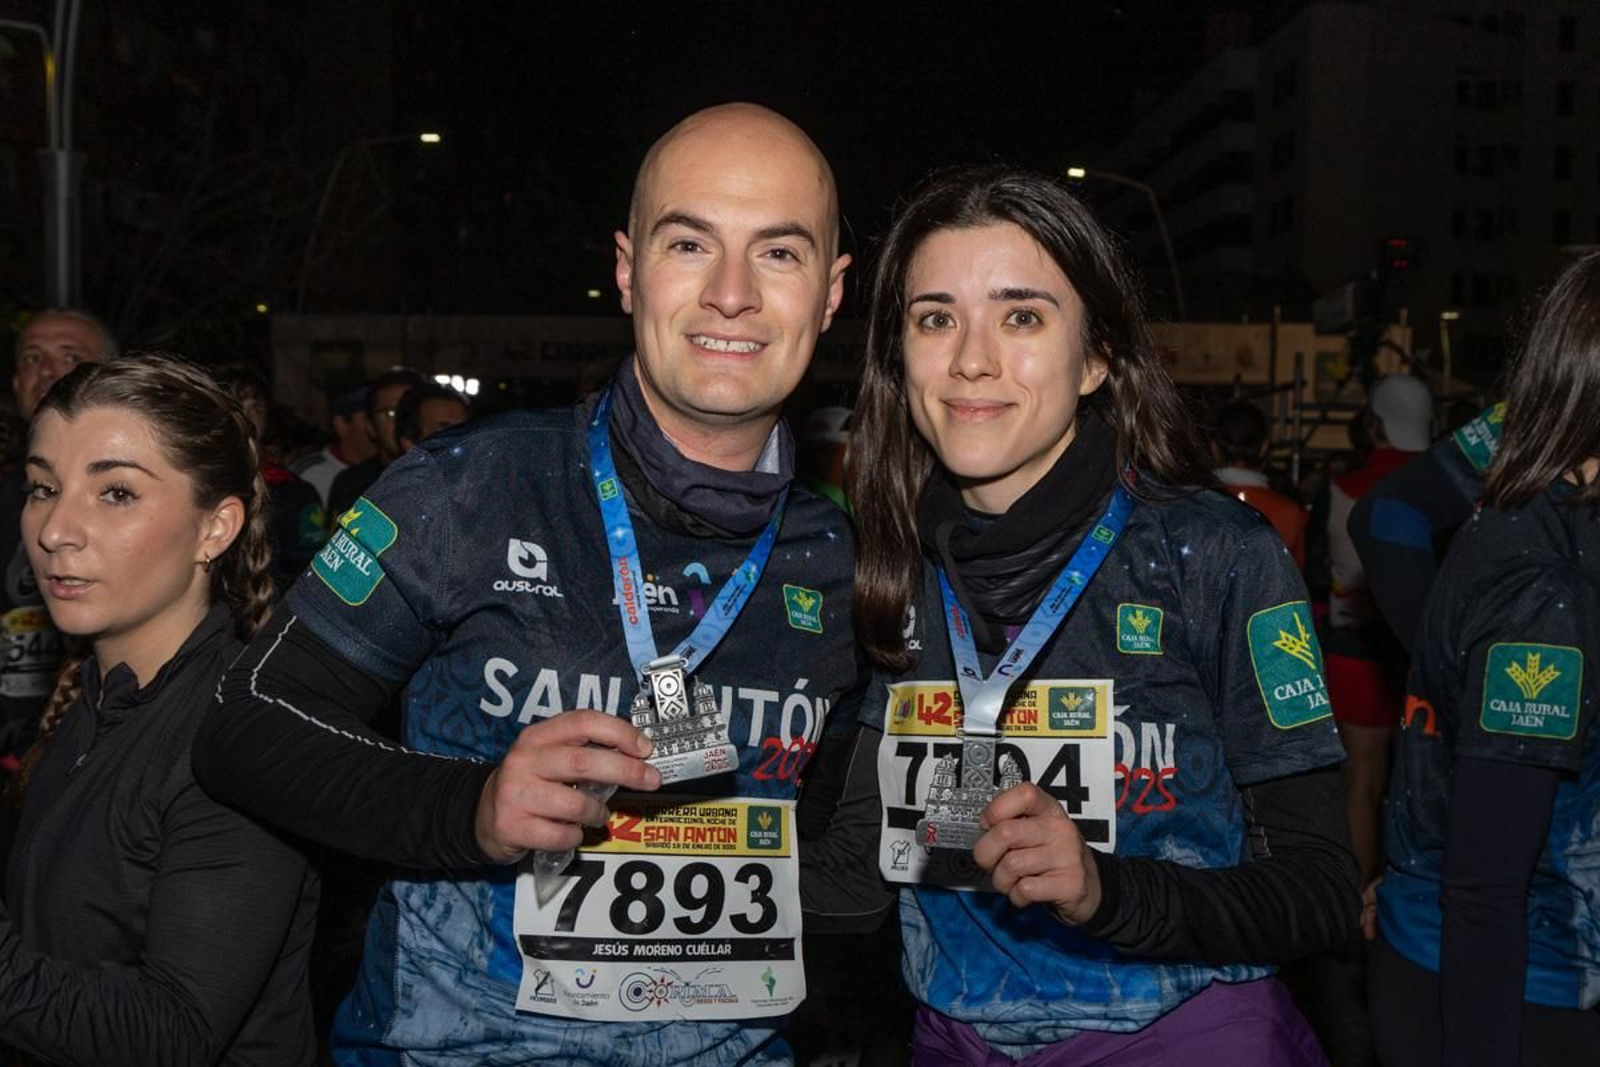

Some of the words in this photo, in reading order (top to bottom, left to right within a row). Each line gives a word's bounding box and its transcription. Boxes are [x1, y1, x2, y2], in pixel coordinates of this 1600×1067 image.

[335, 532, 374, 577] RURAL
[479, 656, 622, 725] SAN
[1273, 677, 1317, 701] CAJA
[917, 691, 952, 726] 42
[1307, 691, 1330, 710] JA
[1490, 699, 1521, 713] CAJA
[1524, 702, 1570, 718] RURAL
[699, 807, 738, 818] URBANA
[643, 826, 680, 842] SAN
[554, 859, 778, 935] 7893
[592, 941, 629, 956] JESÚS
[632, 943, 682, 957] MORENO
[685, 942, 733, 956] CUÉLLAR
